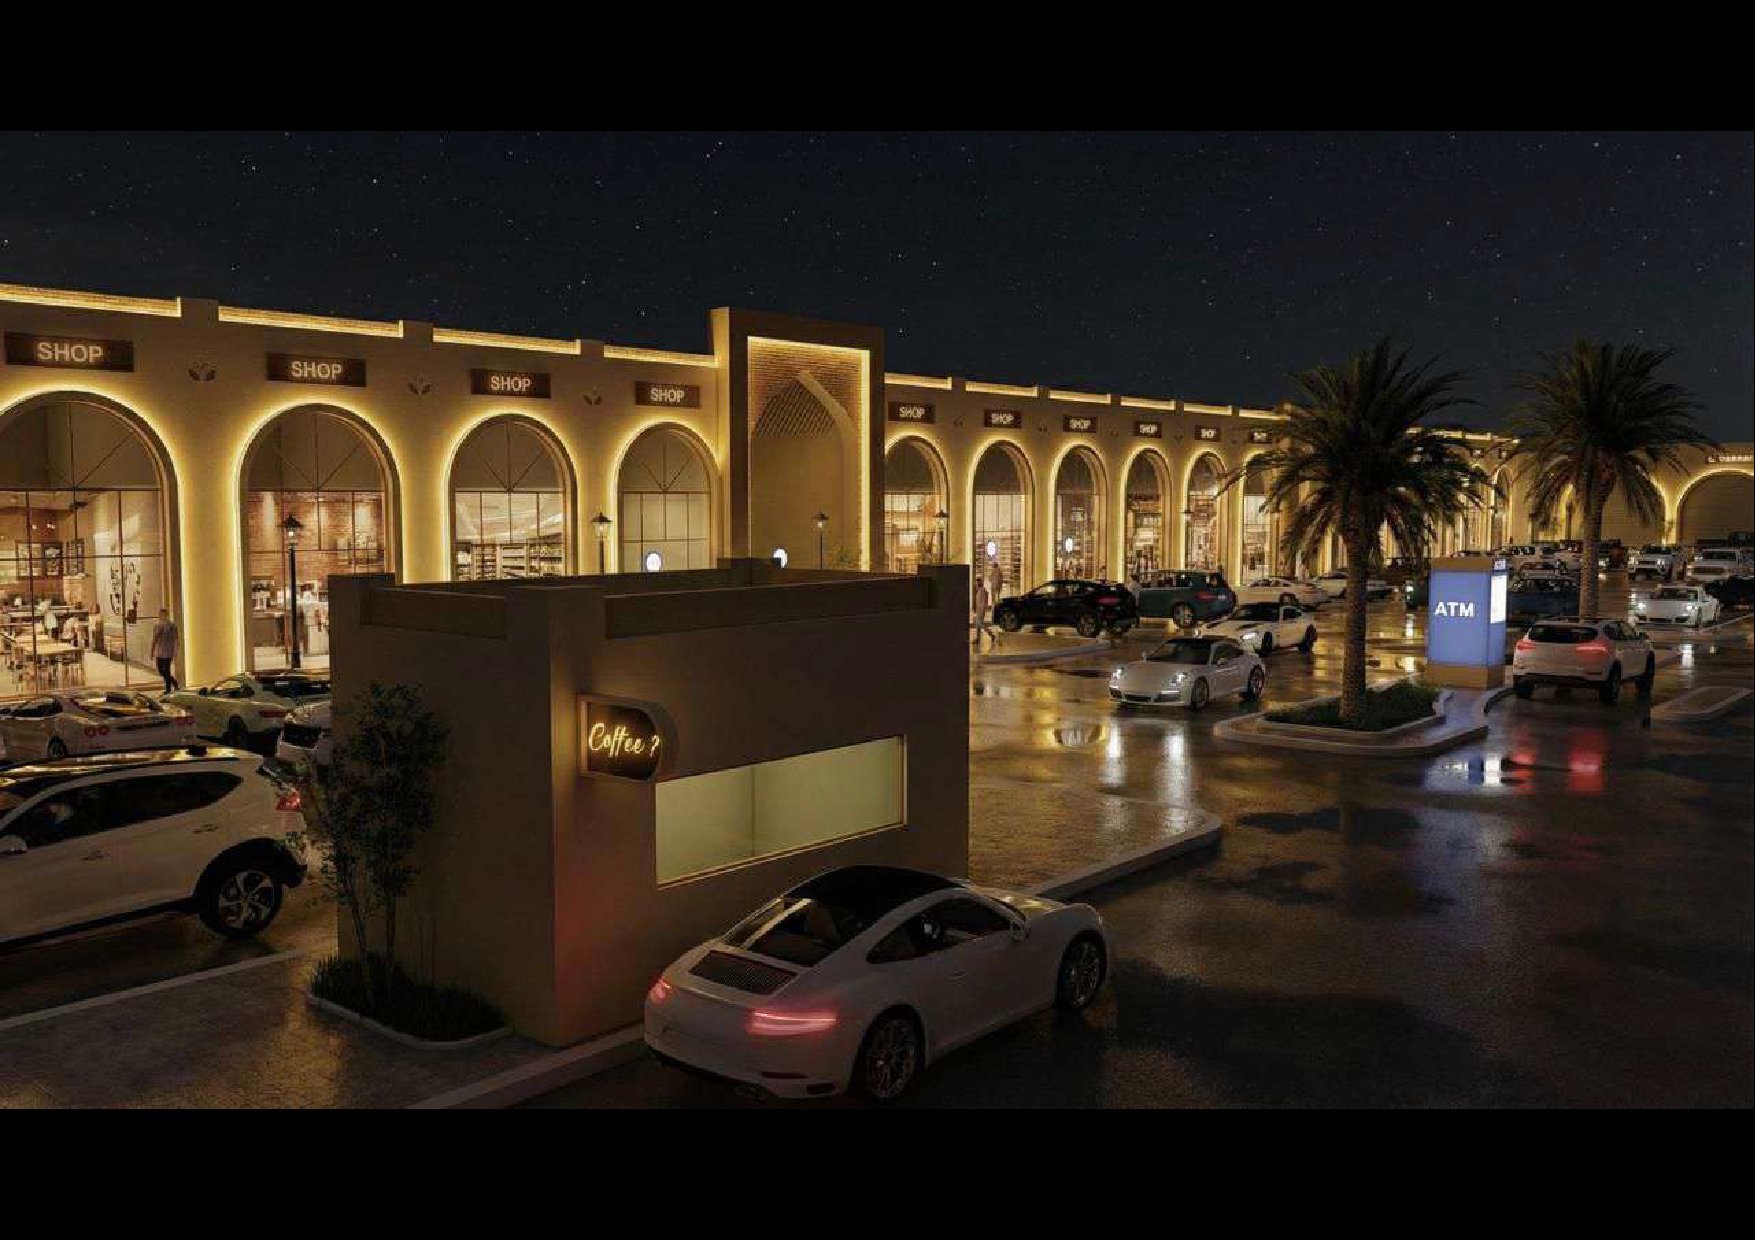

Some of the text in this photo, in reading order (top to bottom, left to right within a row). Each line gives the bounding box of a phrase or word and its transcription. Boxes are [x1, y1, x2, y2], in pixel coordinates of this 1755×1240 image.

[37, 342, 104, 363] SHOP
[291, 360, 343, 379] SHOP
[490, 375, 532, 392] SHOP
[650, 387, 685, 403] SHOP
[899, 406, 926, 418] SHOP
[1434, 601, 1475, 617] ATM
[588, 722, 646, 758] Coffee
